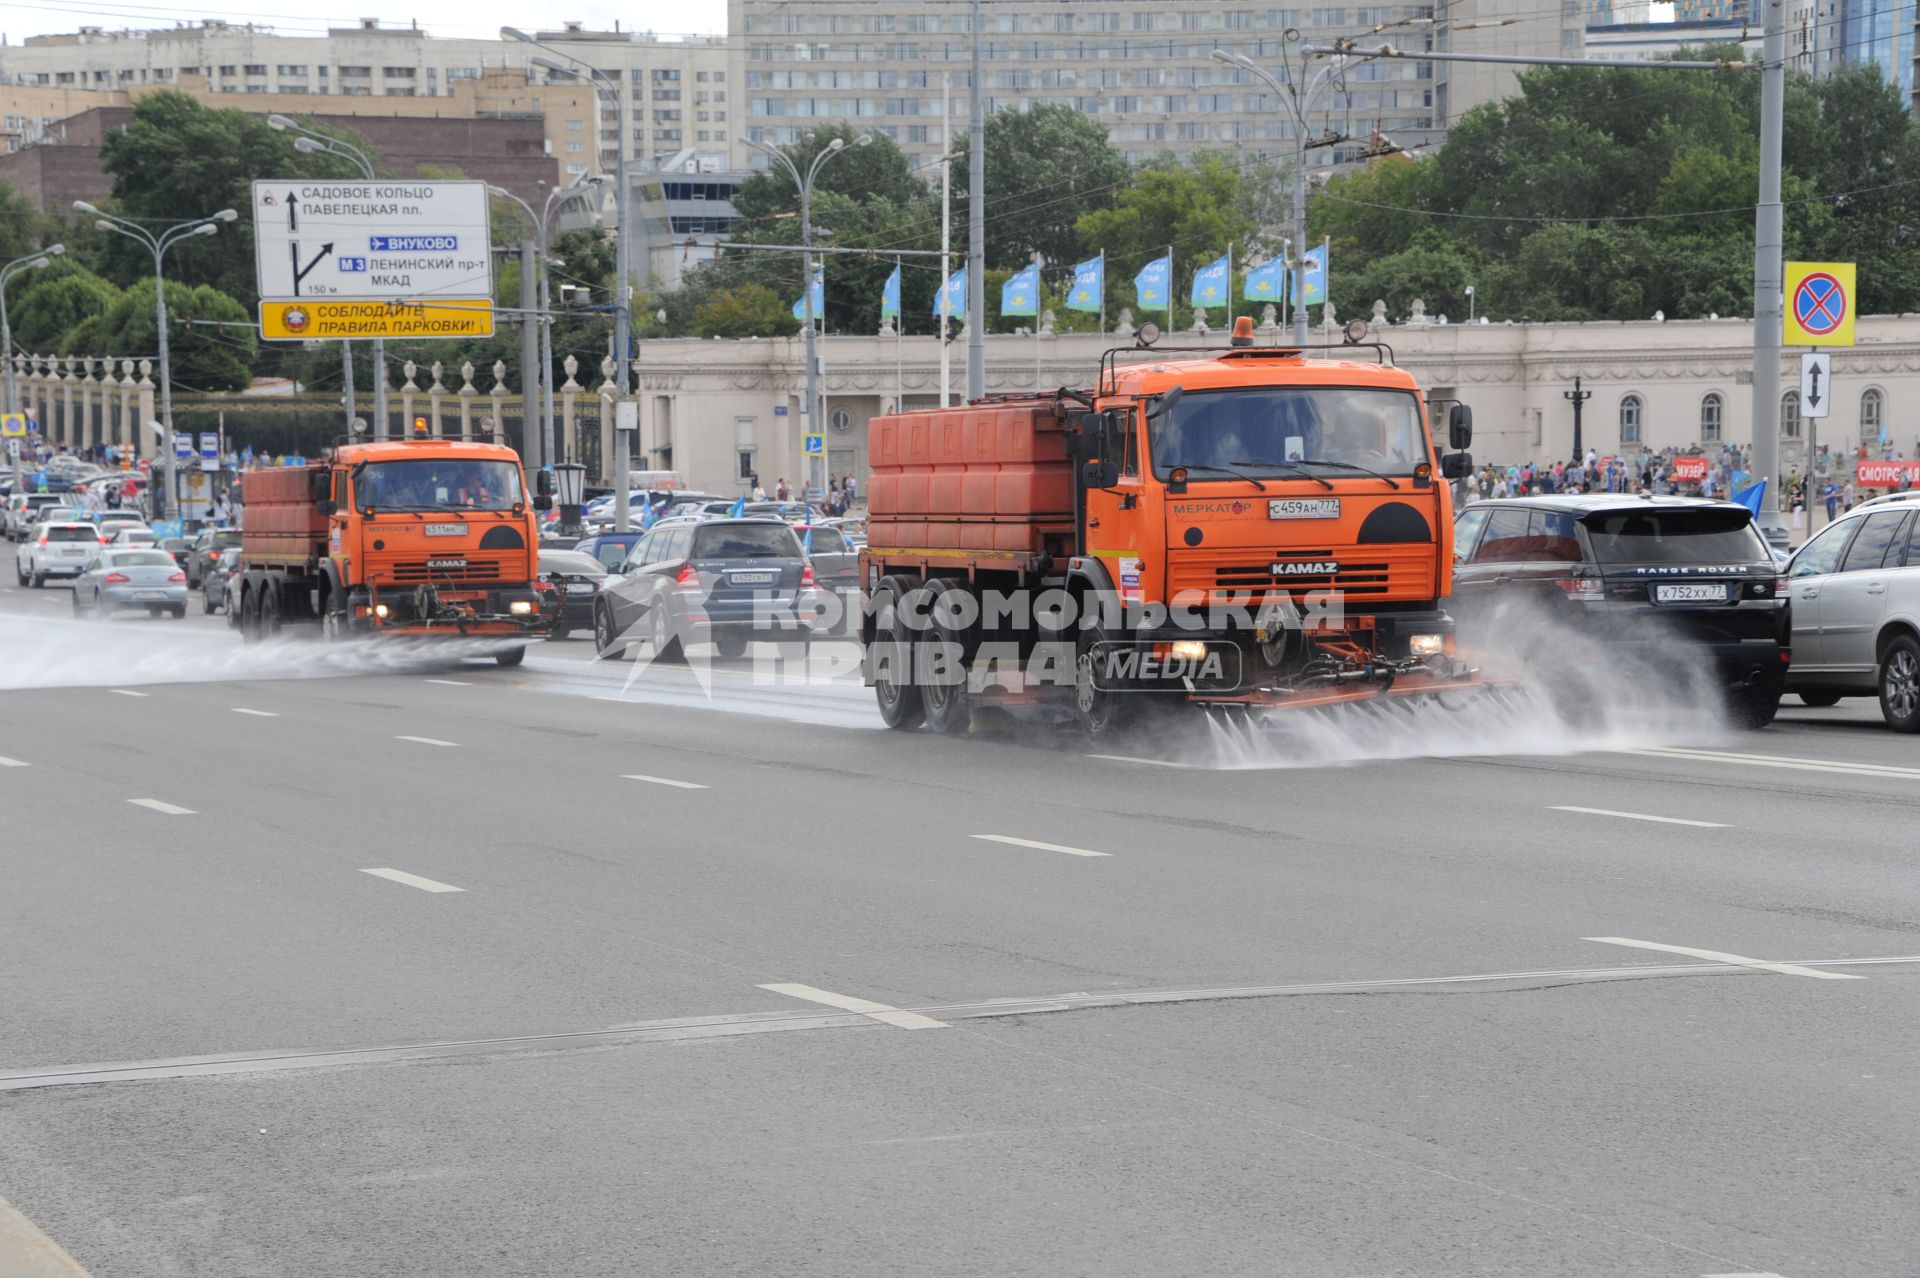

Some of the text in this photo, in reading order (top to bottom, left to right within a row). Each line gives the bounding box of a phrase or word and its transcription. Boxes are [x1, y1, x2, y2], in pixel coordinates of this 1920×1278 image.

[302, 187, 433, 200] САДОВОЕ КОЛЬЦО
[303, 204, 423, 217] ПАВЕЛЕЦКАЯ пл.
[388, 237, 456, 250] ВНУКОВО
[370, 257, 486, 272] ЛЕНИНСКИЙ пр-т
[371, 275, 411, 287] МКАД
[308, 285, 326, 294] 150
[318, 304, 423, 319] СОБЛЮДАЙТЕ
[318, 320, 475, 333] ПРАВИЛА ПАРКОВКИ!
[1677, 462, 1705, 478] МУЗЕЙ
[427, 560, 468, 568] KAMAZ
[1272, 562, 1338, 574] KAMAZ
